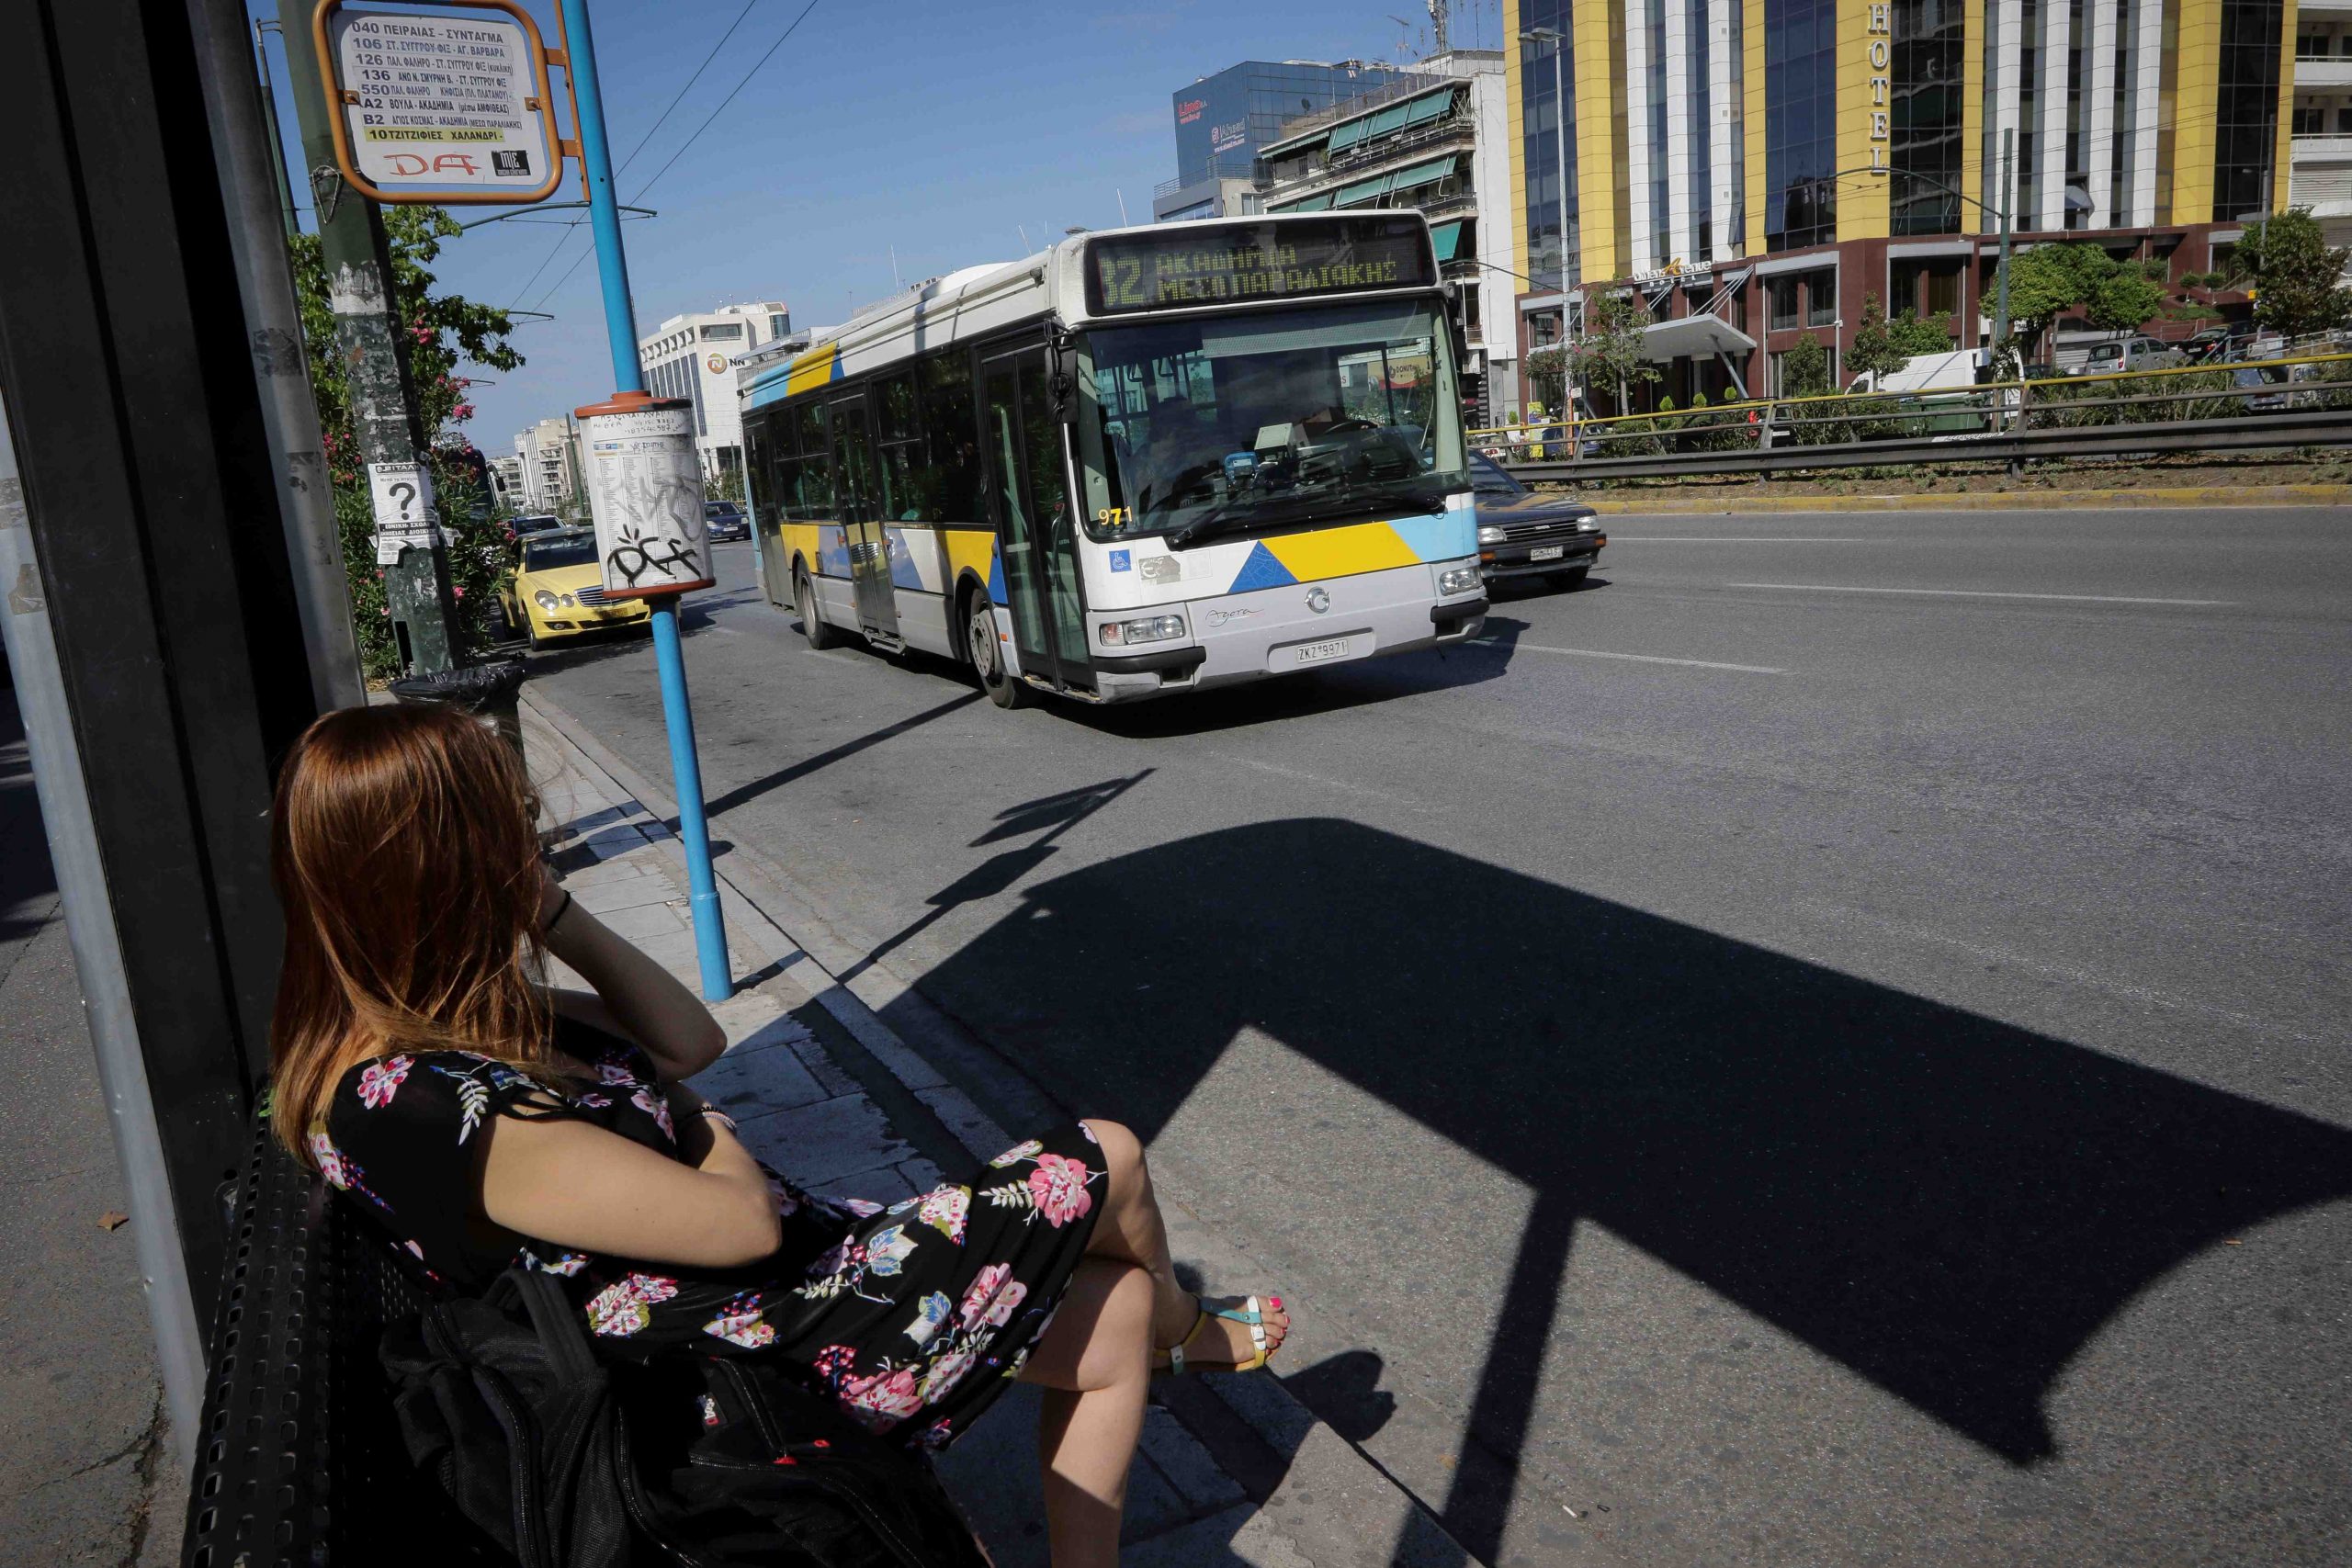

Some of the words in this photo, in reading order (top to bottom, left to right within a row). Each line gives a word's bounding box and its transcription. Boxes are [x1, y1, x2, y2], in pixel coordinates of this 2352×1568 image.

[352, 22, 379, 33] 040
[383, 25, 435, 37] ΠΕΙΡΑΙΑΣ
[447, 29, 503, 43] ΣΥΝΤΑΓΜΑ
[353, 38, 382, 50] 106
[401, 41, 435, 52] ΣΥΓΓΡΟΥ
[470, 47, 505, 58] ΒΑΡΒΑΡΑ
[356, 54, 383, 65] 126
[404, 57, 430, 67] ΦΑΛΗΡΟ
[362, 70, 390, 81] 136
[398, 72, 412, 82] ΑΝΩ
[420, 73, 447, 84] ΣΜΥΡΝΗ
[361, 84, 390, 95] 550
[1868, 4, 1890, 176] HOTEL
[364, 98, 383, 108] Α2
[390, 99, 413, 109] ΒΟΥΛΑ
[419, 100, 454, 110] ΑΚΑΔΗΜΙΑ
[363, 115, 385, 125] Β2
[369, 130, 387, 140] 10
[388, 130, 444, 140] ΤΖΙΤΖΙΦΙΕΣ
[450, 131, 498, 141] ΧΑΛΑΝΔΡΙ
[1098, 505, 1133, 525] 971
[1204, 607, 1265, 628] Agora
